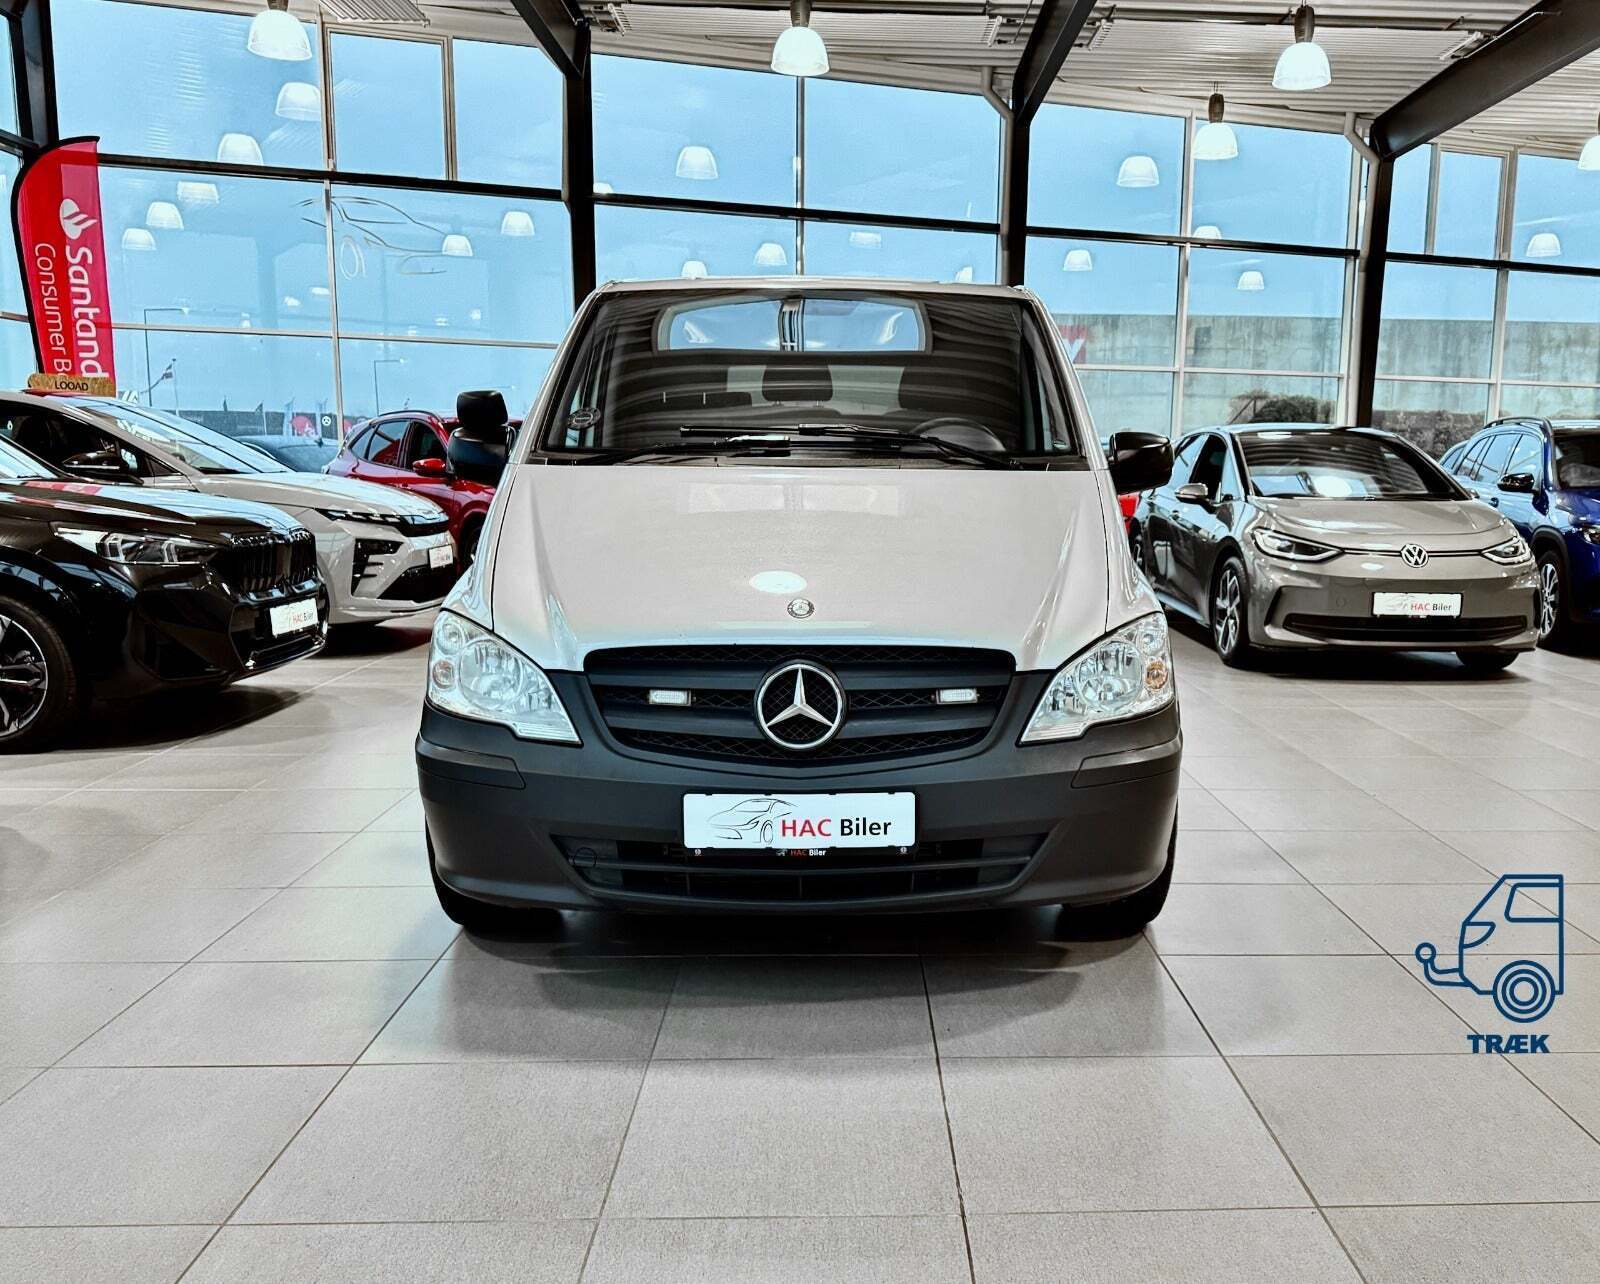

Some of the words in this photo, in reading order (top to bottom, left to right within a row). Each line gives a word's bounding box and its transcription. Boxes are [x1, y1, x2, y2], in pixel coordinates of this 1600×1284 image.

[35, 243, 65, 354] Consumer
[53, 357, 72, 378] B
[65, 246, 109, 377] Santand
[1410, 603, 1430, 611] HAC
[1432, 603, 1452, 611] Biler
[781, 819, 832, 837] HAC
[840, 817, 892, 836] Biler
[790, 849, 807, 857] HAC
[809, 848, 826, 857] Biler
